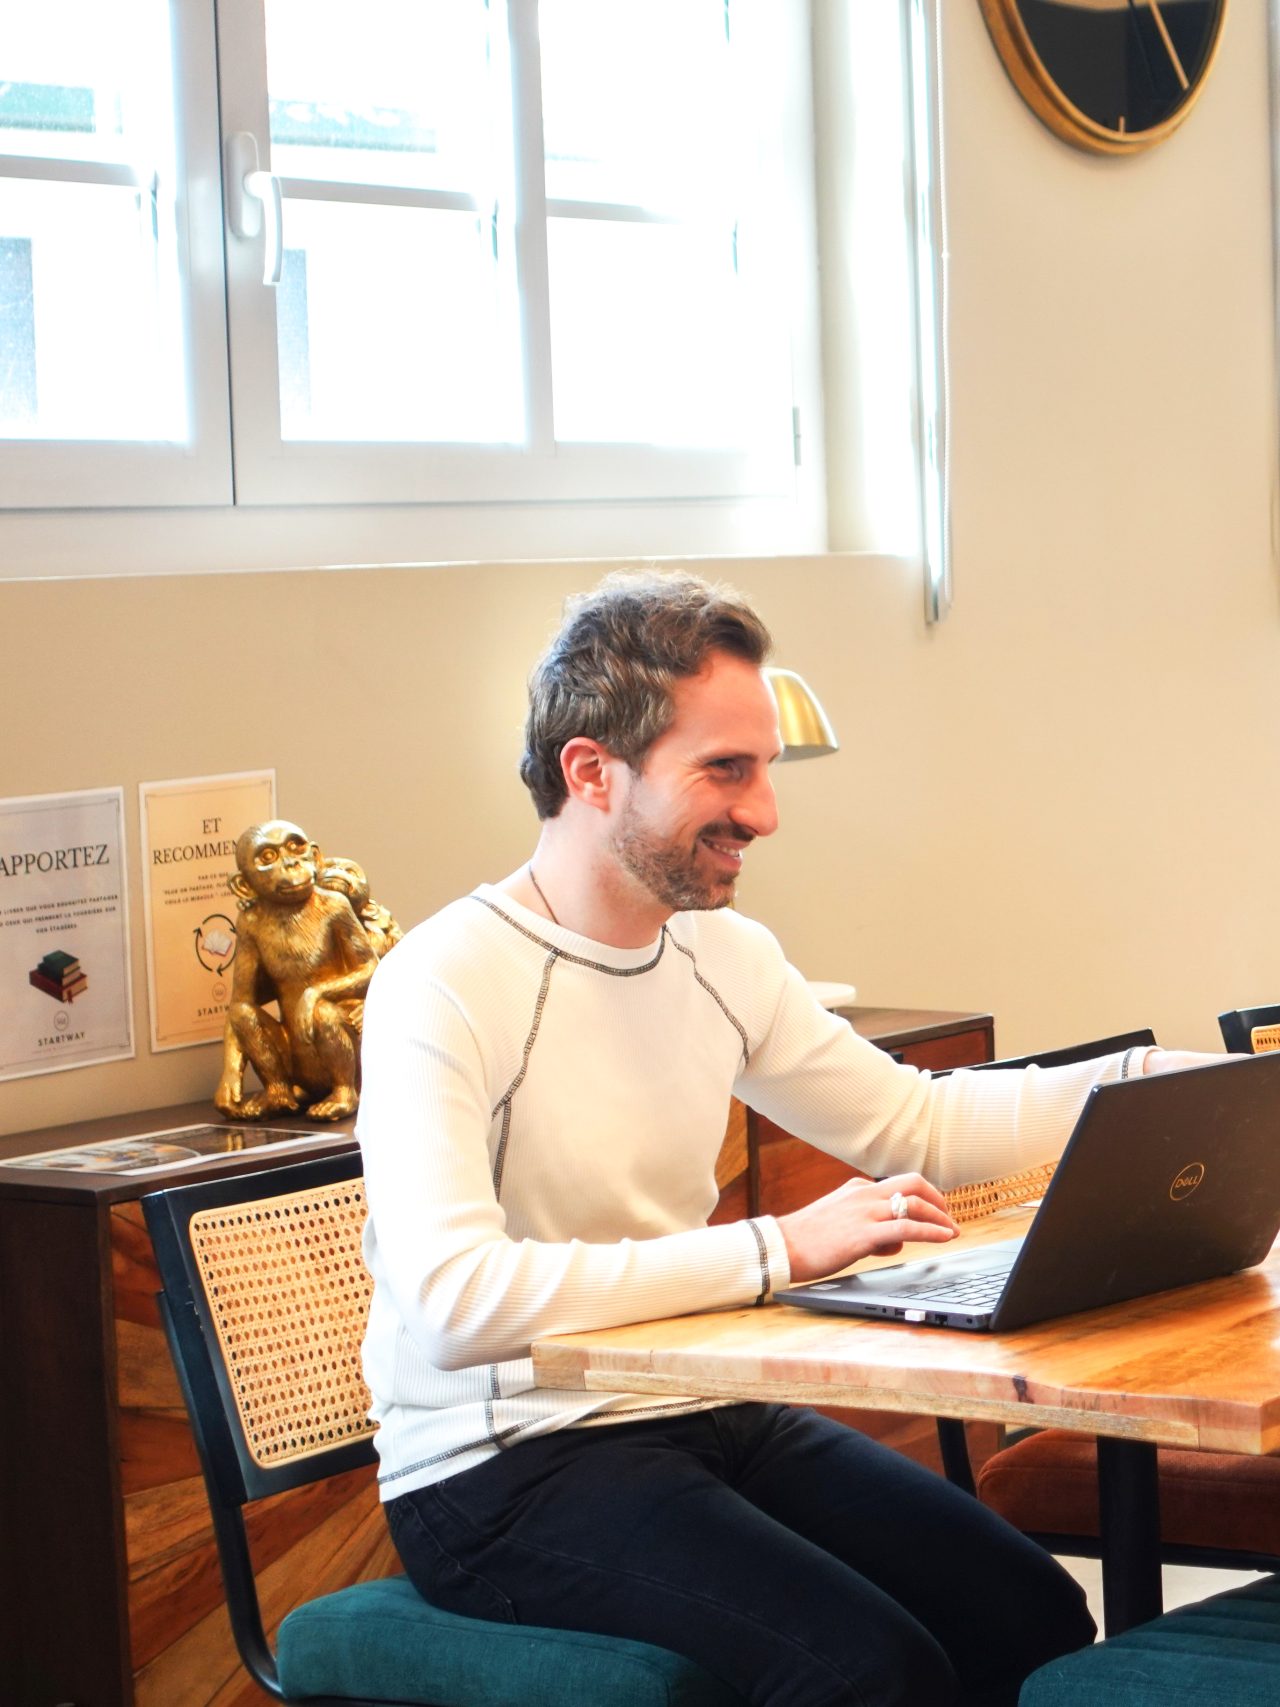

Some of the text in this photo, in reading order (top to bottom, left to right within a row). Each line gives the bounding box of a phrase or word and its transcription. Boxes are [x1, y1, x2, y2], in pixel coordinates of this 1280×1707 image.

[202, 817, 222, 834] ET
[152, 839, 239, 865] RECOMMEN
[198, 1004, 230, 1017] STARTW
[38, 1031, 85, 1047] STARTWAY
[1174, 1175, 1199, 1189] DELL
